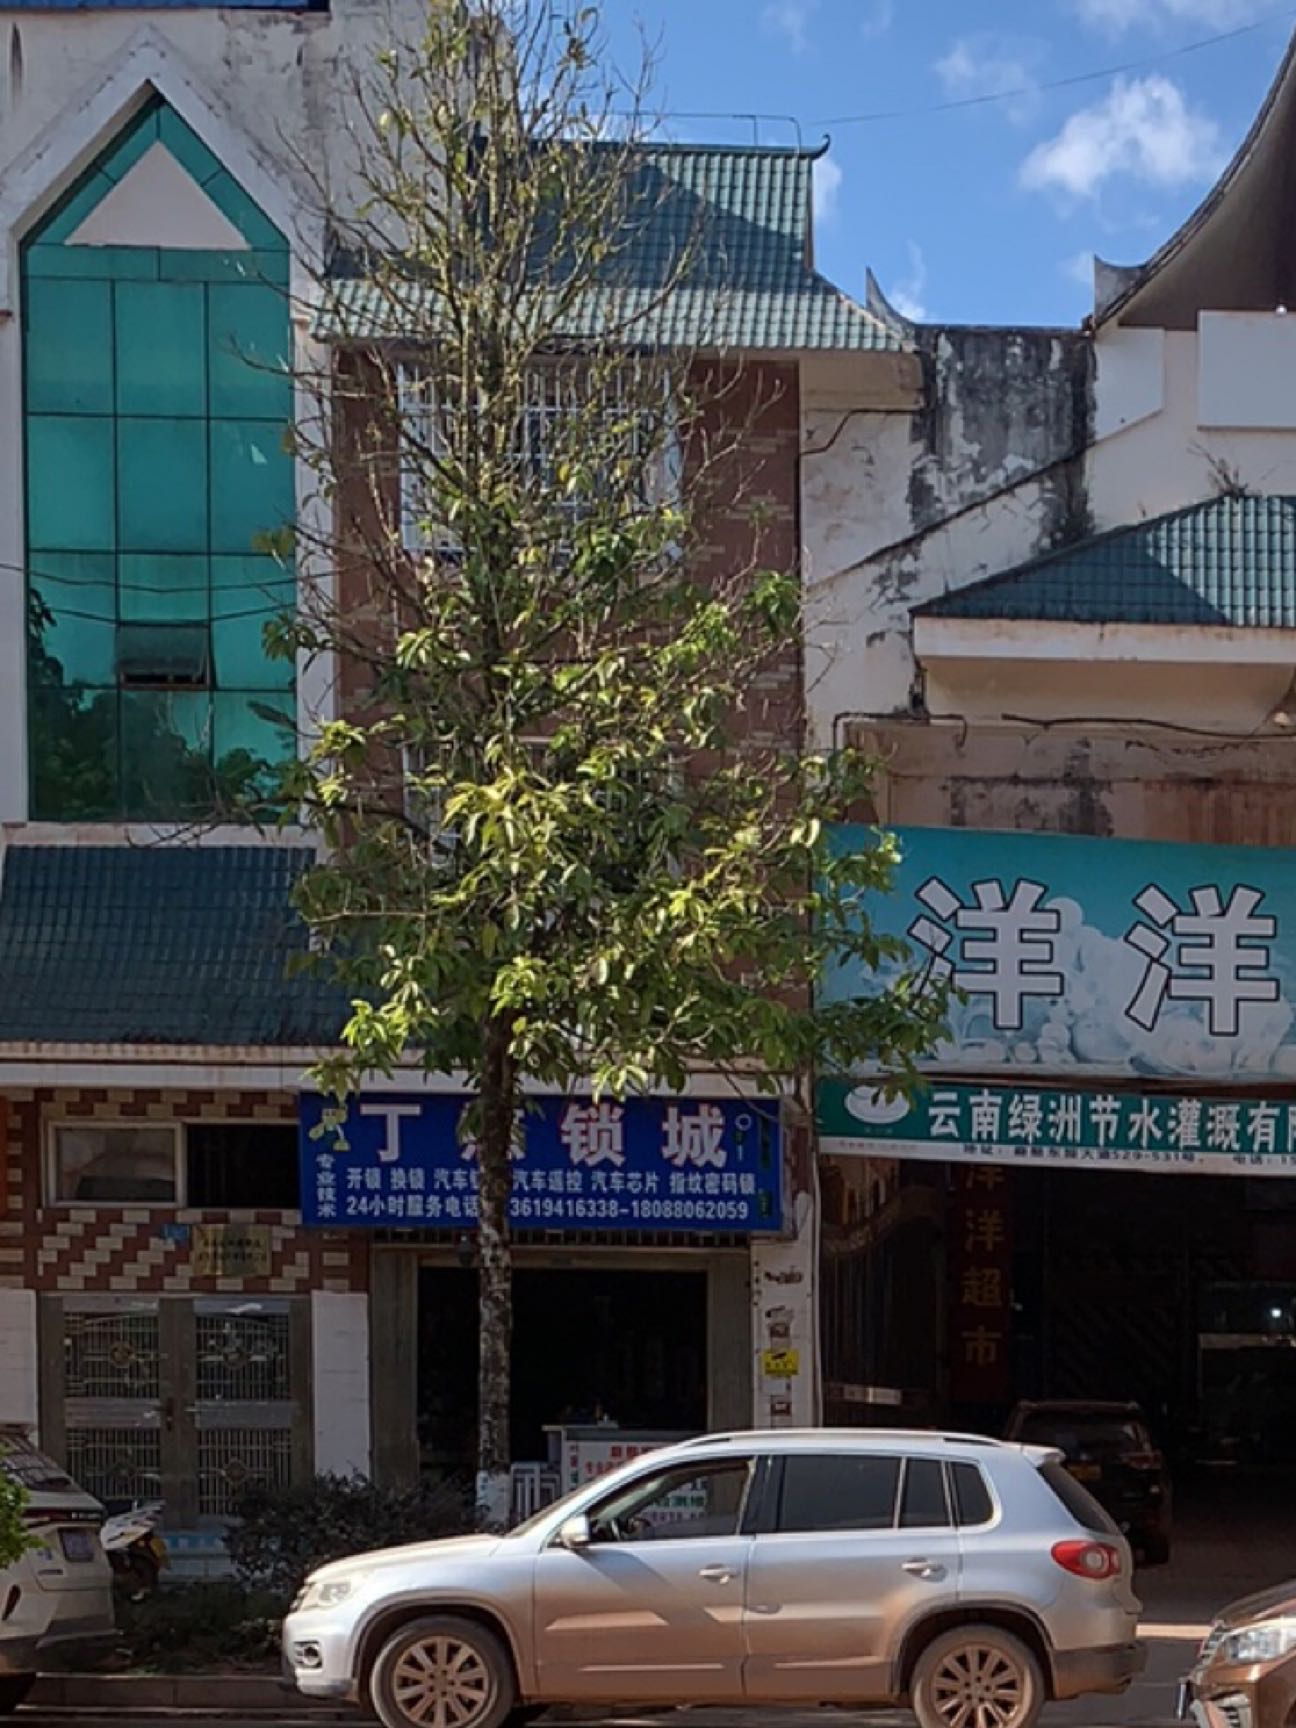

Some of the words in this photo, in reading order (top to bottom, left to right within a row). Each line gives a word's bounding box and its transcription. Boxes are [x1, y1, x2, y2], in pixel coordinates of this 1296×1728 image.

[359, 1102, 729, 1168] 丁锁城
[346, 1167, 382, 1190] 开锁
